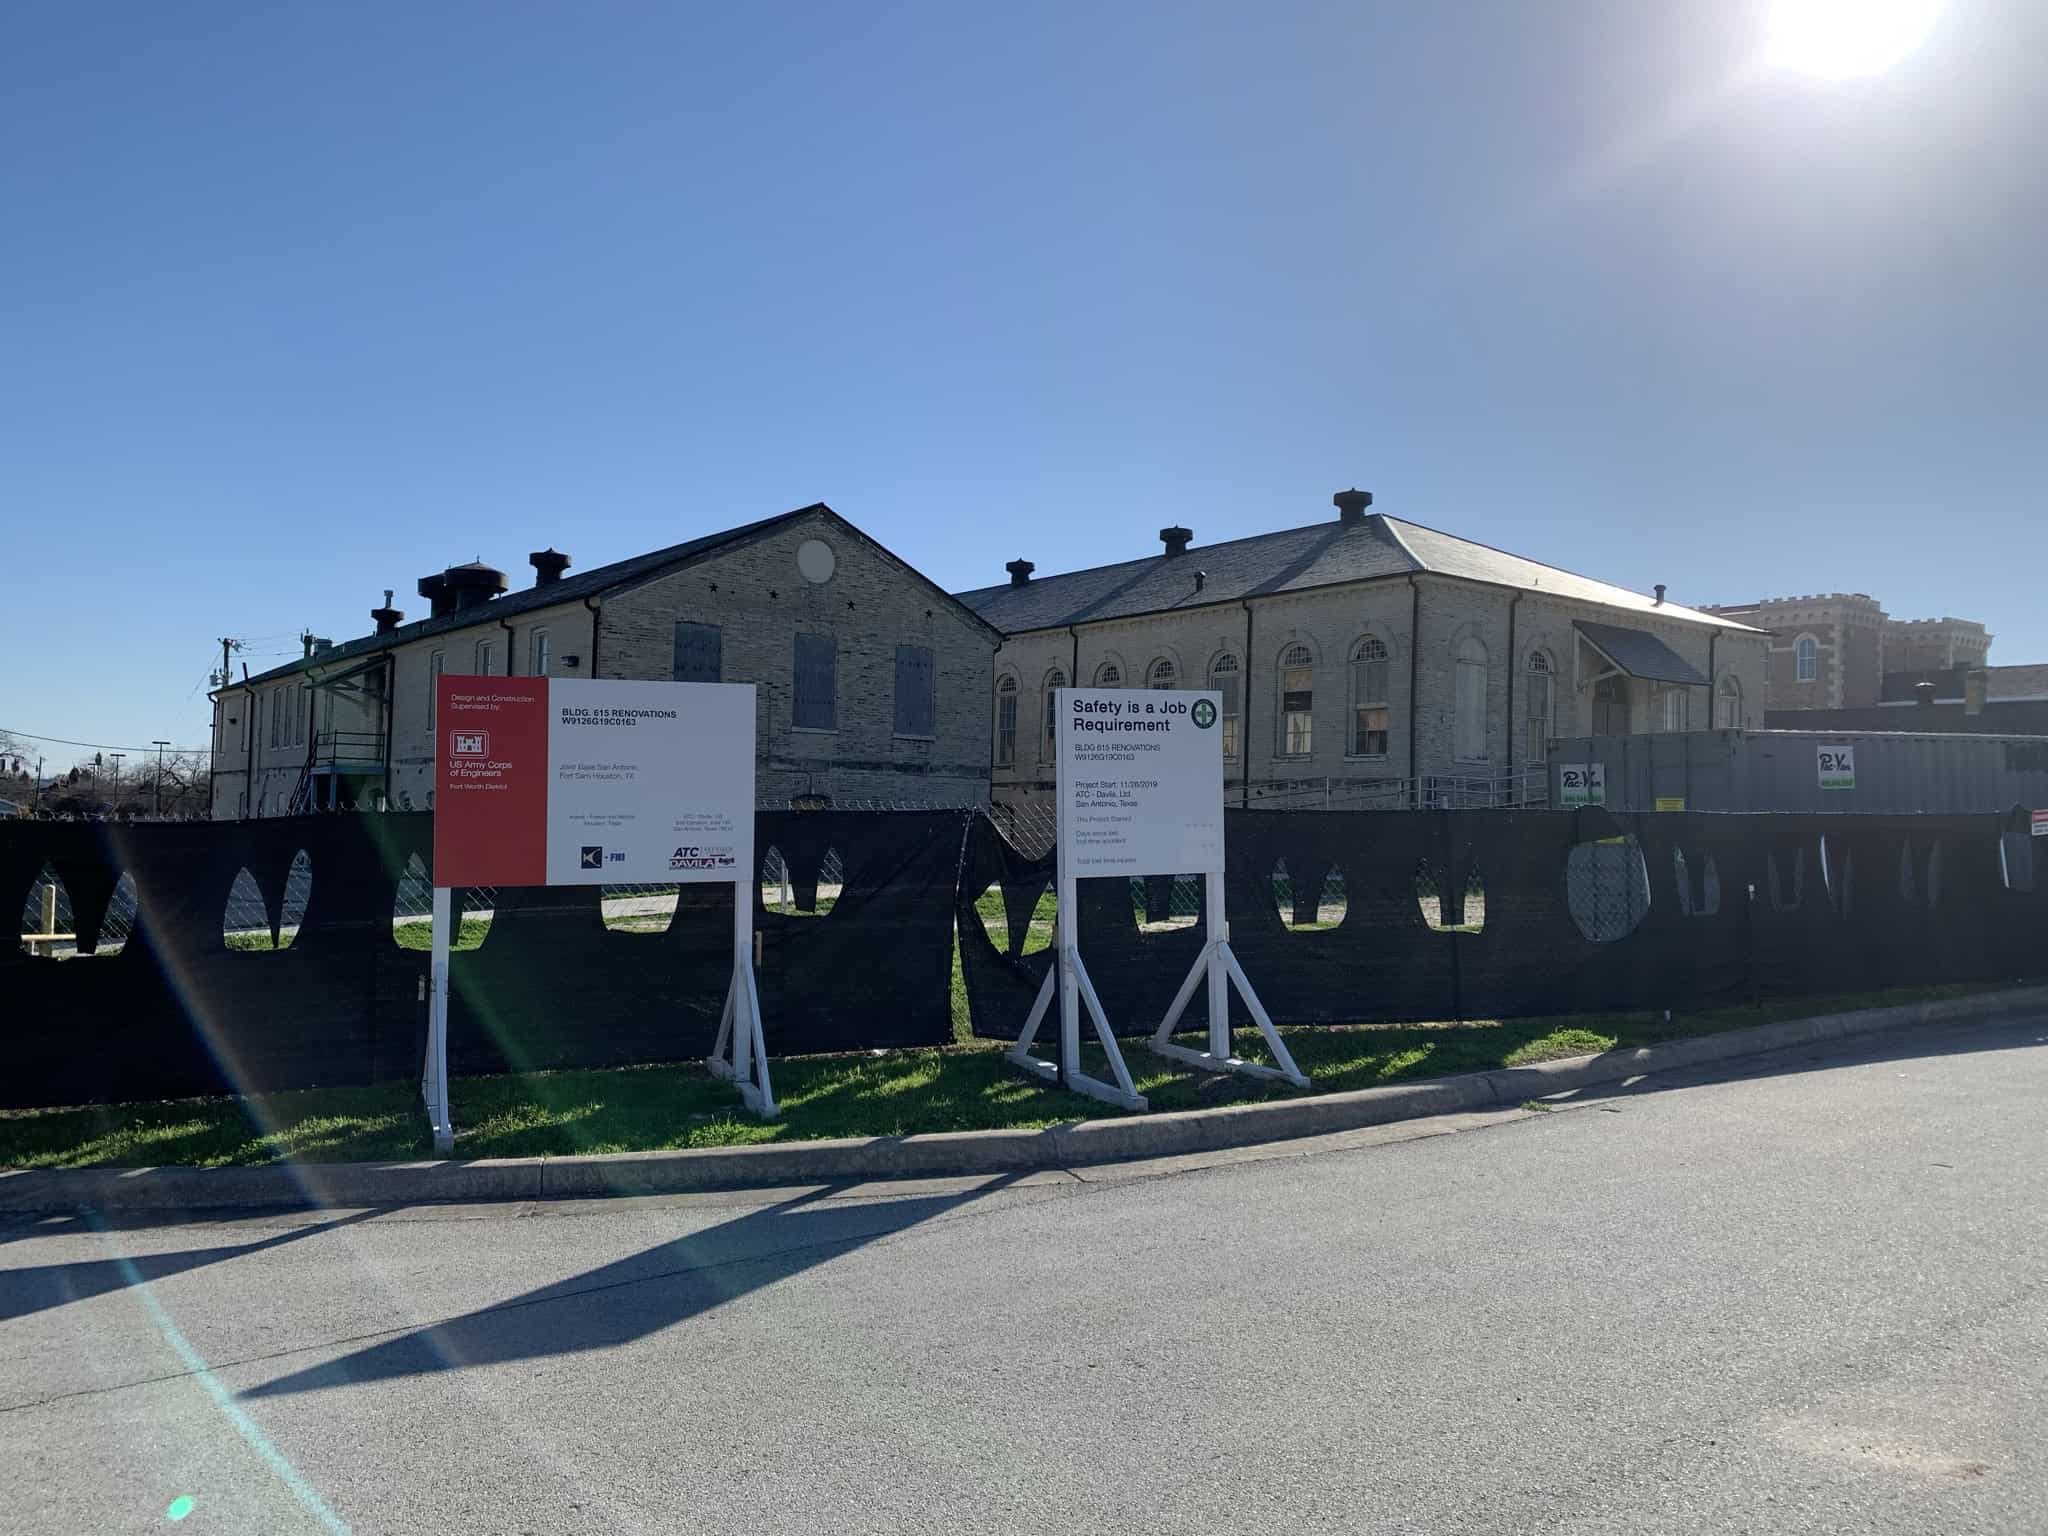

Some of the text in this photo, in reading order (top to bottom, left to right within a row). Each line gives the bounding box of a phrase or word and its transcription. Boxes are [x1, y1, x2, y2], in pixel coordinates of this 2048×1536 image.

[451, 694, 536, 704] Design and Construction
[450, 702, 490, 712] Supervised
[1072, 699, 1188, 716] Safety is a Job
[561, 708, 678, 719] BLDG. 615 RENOVATIONS
[1073, 717, 1171, 734] Requirement
[1111, 743, 1161, 753] RENOVATIONS
[449, 760, 513, 771] US Army Corps
[449, 769, 502, 780] of Engineers
[449, 783, 508, 791] Fort Worth District
[1075, 780, 1100, 791] Project
[1075, 790, 1090, 799] ATC
[1075, 800, 1090, 809] San
[673, 847, 699, 858] ATC
[669, 859, 715, 870] DAVILA
